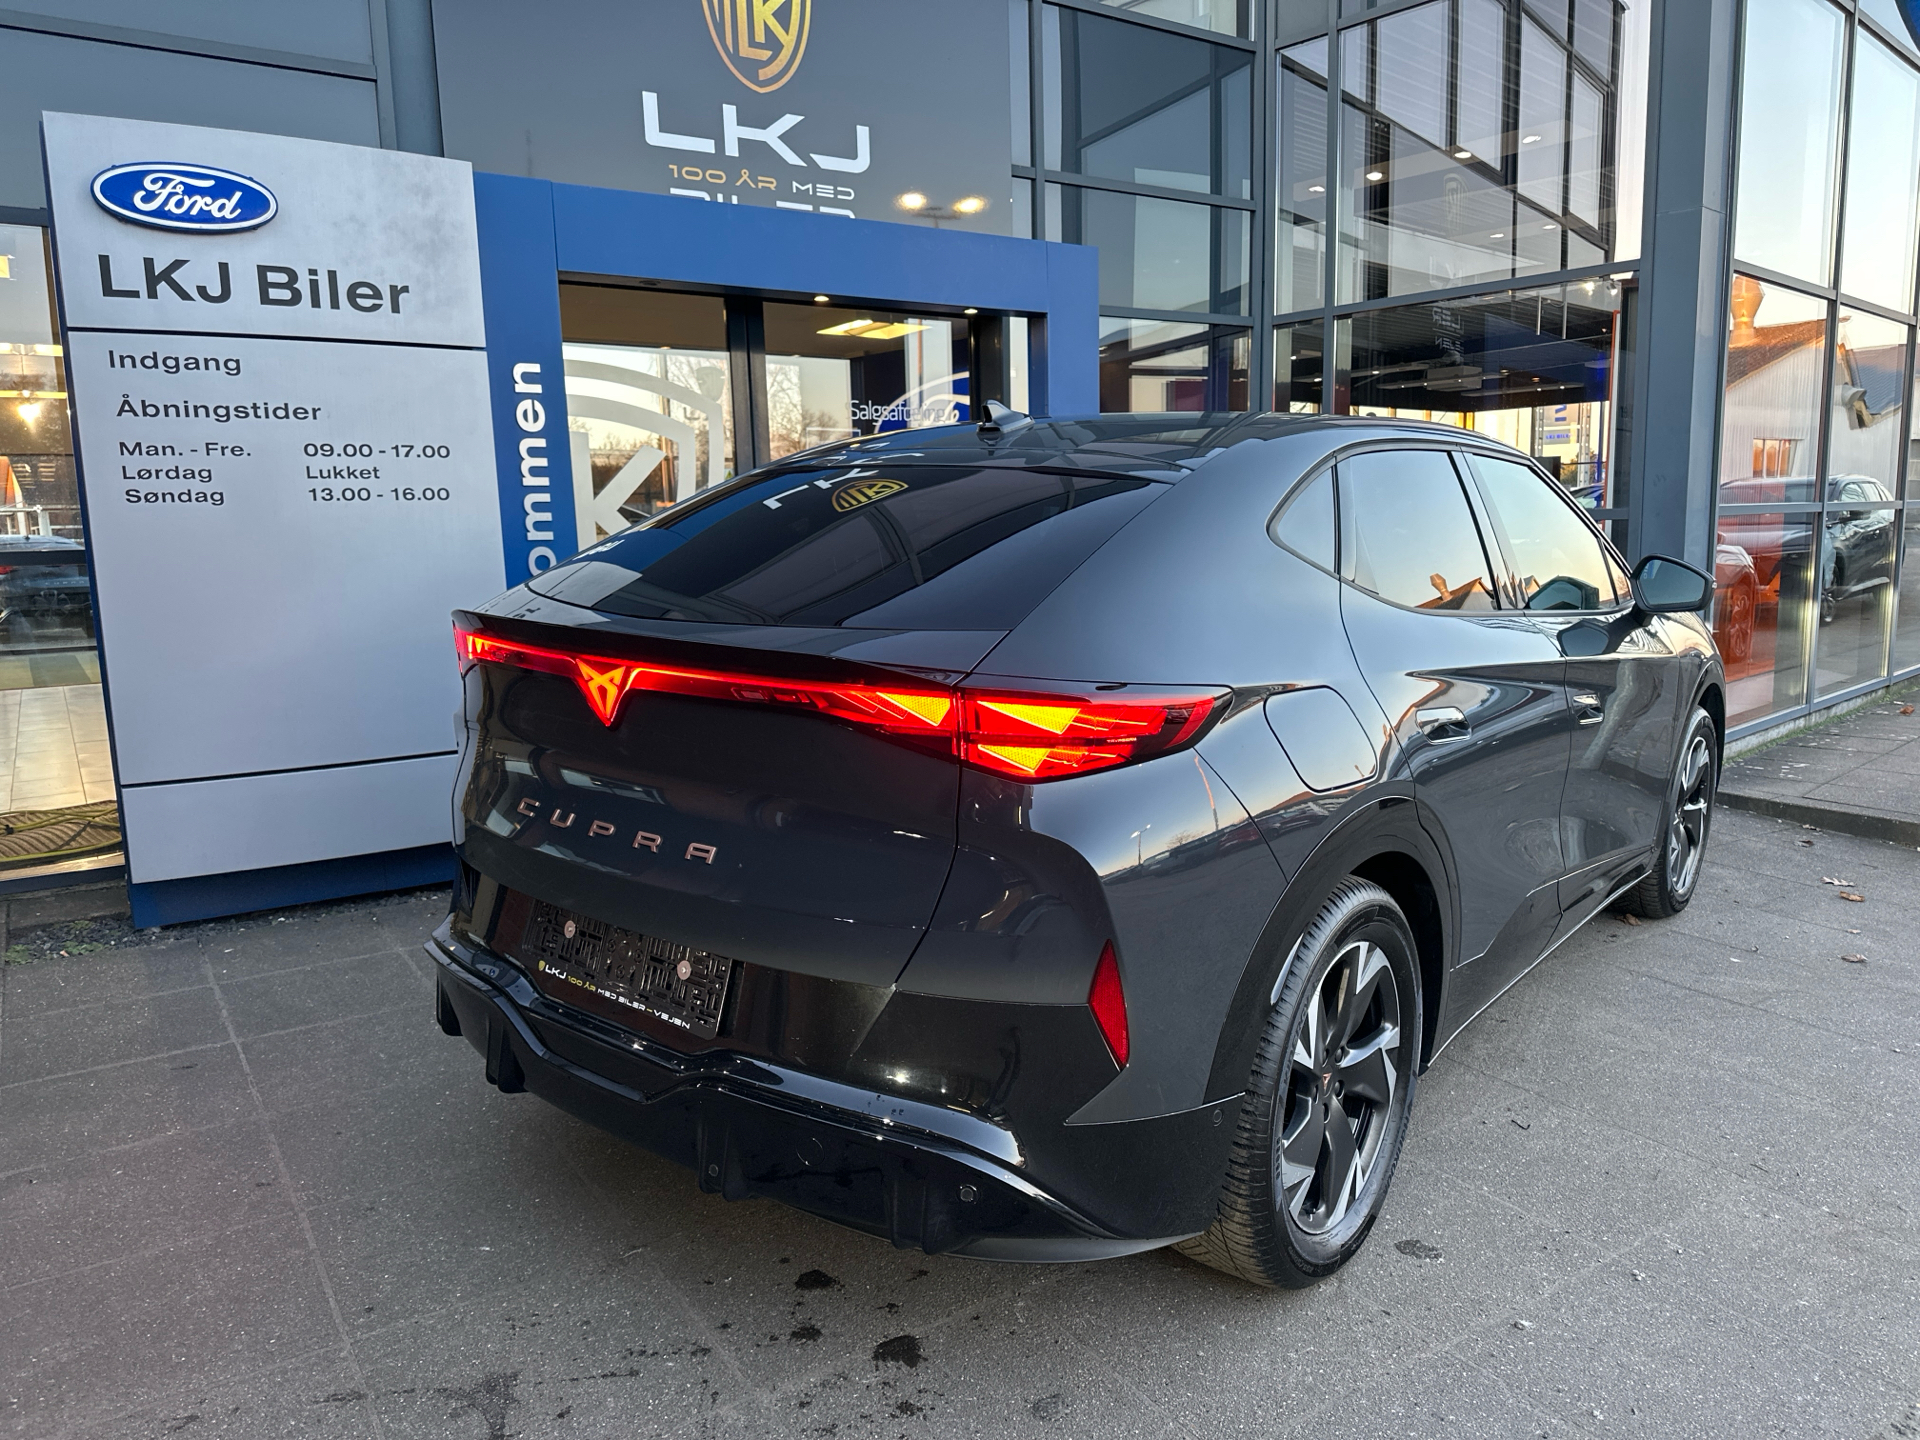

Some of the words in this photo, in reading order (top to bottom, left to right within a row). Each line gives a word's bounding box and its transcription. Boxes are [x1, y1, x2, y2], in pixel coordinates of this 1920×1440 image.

[642, 91, 871, 174] LKJ
[133, 172, 242, 219] Ford
[668, 164, 726, 184] 100
[735, 169, 777, 190] ÅR
[792, 181, 855, 200] MED
[98, 254, 232, 304] LKJ
[256, 264, 410, 315] Biler
[108, 349, 242, 377] Indgang
[116, 393, 321, 423] Åbningstider
[119, 441, 184, 456] Man.
[205, 442, 251, 457] Fre.
[303, 443, 373, 457] 09.00
[391, 444, 451, 458] 17.00
[122, 465, 212, 483] Lørdag
[306, 466, 380, 479] Lukket
[125, 489, 225, 506] Søndag
[308, 487, 371, 501] 13.00
[391, 487, 450, 501] 16.00
[516, 797, 718, 865] CUPRA
[545, 964, 567, 979] LKJ
[567, 975, 583, 987] 100
[618, 997, 646, 1012] BILER
[653, 1009, 690, 1030] VEJEN
